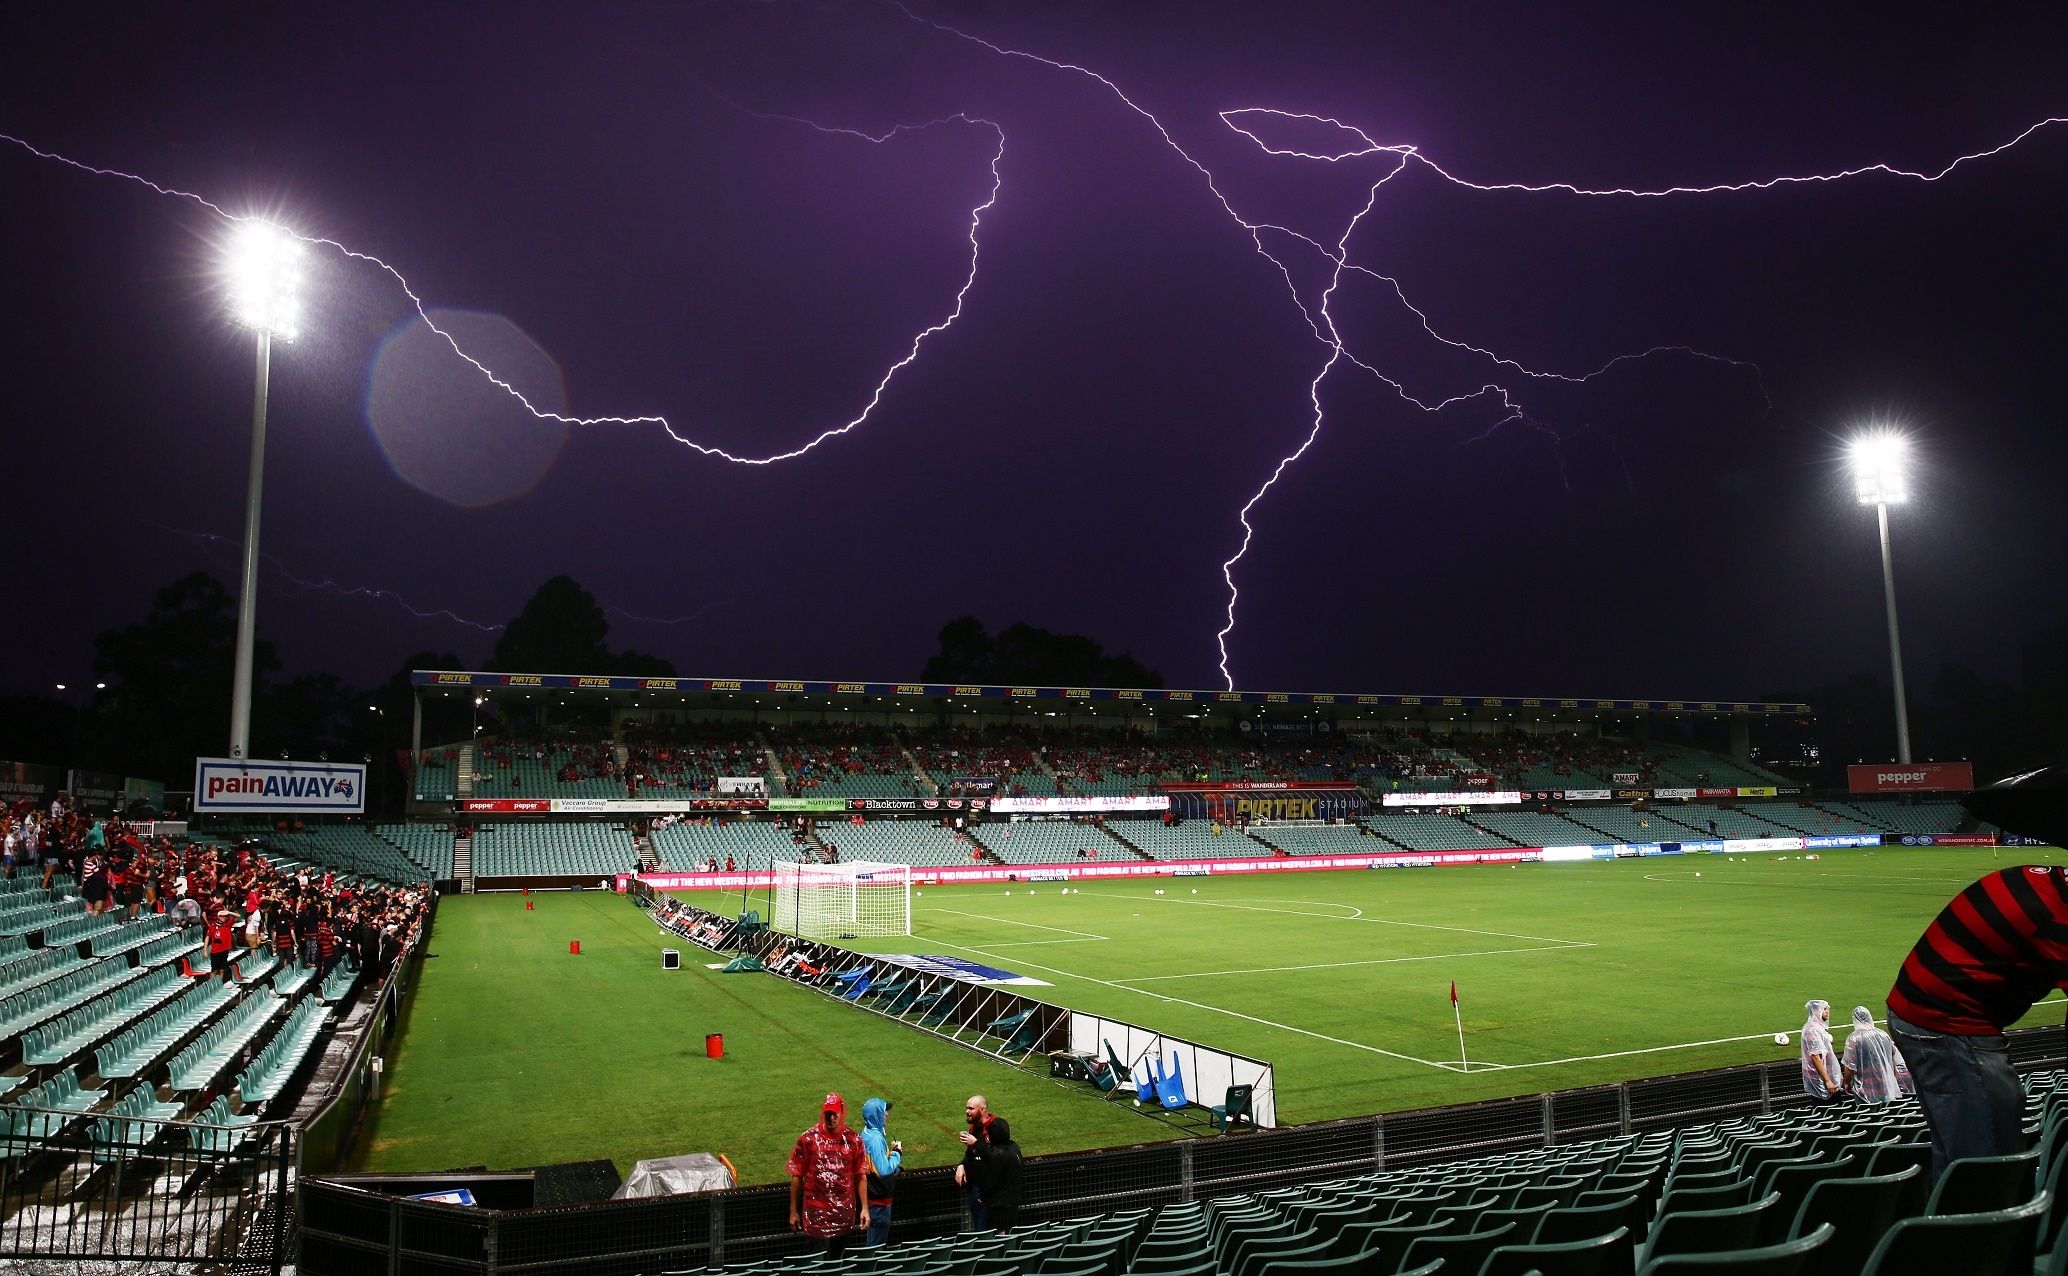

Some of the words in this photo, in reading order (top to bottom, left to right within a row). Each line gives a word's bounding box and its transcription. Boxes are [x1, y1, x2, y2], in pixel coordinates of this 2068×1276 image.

[438, 673, 472, 682] PIRTEK
[510, 676, 542, 684] PIRTEK
[579, 678, 610, 686] PIRTEK
[1878, 772, 1926, 784] pepper
[208, 772, 336, 798] painAWAY
[866, 800, 916, 809] Blacktown
[1235, 799, 1318, 819] PIRTEK
[1320, 800, 1368, 809] STADIUM
[681, 878, 694, 887] THE
[695, 878, 713, 886] NEW
